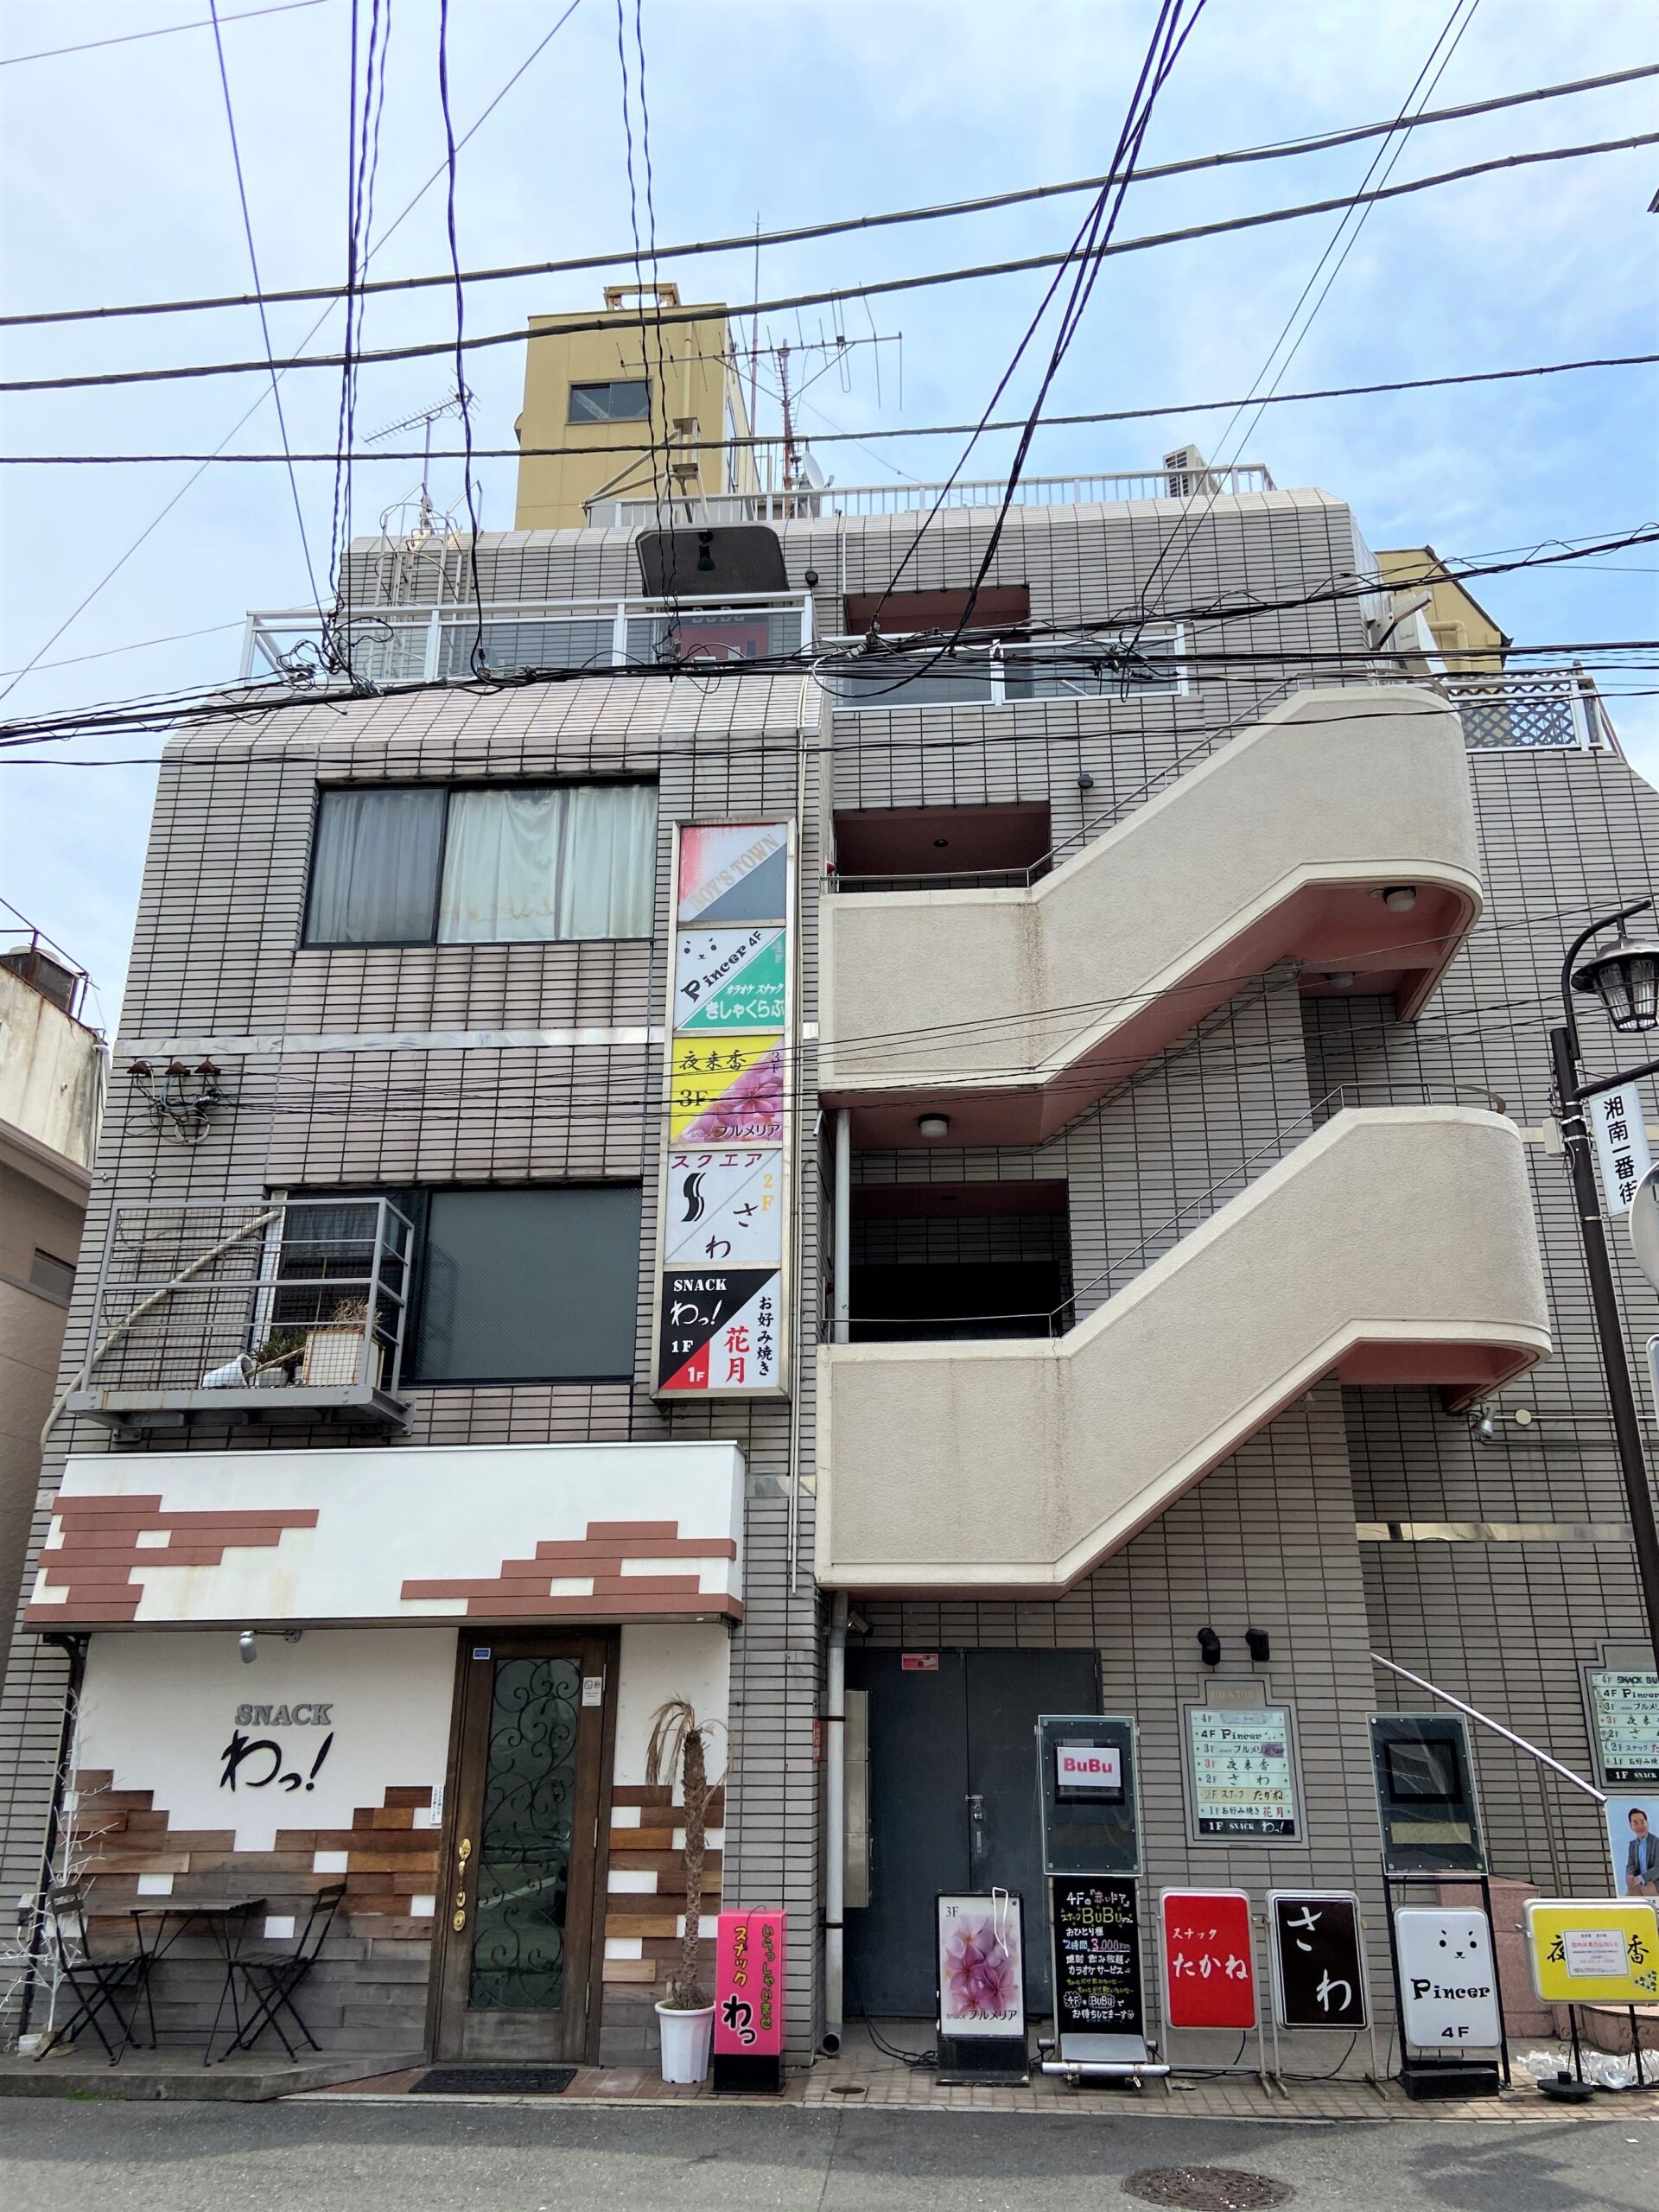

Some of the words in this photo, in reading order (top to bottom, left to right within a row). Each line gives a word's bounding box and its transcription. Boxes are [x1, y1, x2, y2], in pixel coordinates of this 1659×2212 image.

[689, 868, 735, 912] BOY'S
[731, 833, 779, 876] TOWN
[681, 945, 747, 1003] Pincer
[748, 930, 762, 947] 4F
[726, 983, 755, 996] カラオケ
[755, 982, 784, 995] スナック
[679, 1049, 747, 1071] 夜来香
[771, 1051, 781, 1073] 3F
[679, 1089, 709, 1108] 3F
[671, 1154, 763, 1169] スクエア
[761, 1173, 774, 1211] 2F
[673, 1278, 728, 1292] SNACK
[757, 1296, 774, 1376] お好み焼き
[671, 1340, 694, 1353] 1F
[724, 1325, 750, 1383] 花月
[688, 1366, 705, 1382] 1F
[234, 1703, 334, 1726] SNACK
[1627, 1715, 1659, 1726] 夜来
[1221, 1728, 1262, 1740] Pincer
[1064, 1757, 1113, 1775] BuBu
[1210, 1806, 1220, 1815] 1F
[1222, 1806, 1260, 1815] お好み焼き
[1262, 1806, 1284, 1818] 花月
[1209, 1821, 1224, 1830] 1F
[946, 1906, 959, 1917] 3F
[1065, 1926, 1104, 1937] おひとり様
[1172, 1927, 1217, 1939] スナック
[734, 1926, 748, 1987] スナック
[1287, 1905, 1351, 2013] さわ
[1068, 1965, 1096, 1976] カラオケ
[1172, 1952, 1249, 1980] たかね
[760, 1924, 775, 2030] いらっしゃいませ
[1410, 1978, 1491, 2000] Pincer
[721, 1993, 756, 2045] わっ
[1441, 2026, 1470, 2039] 4F
